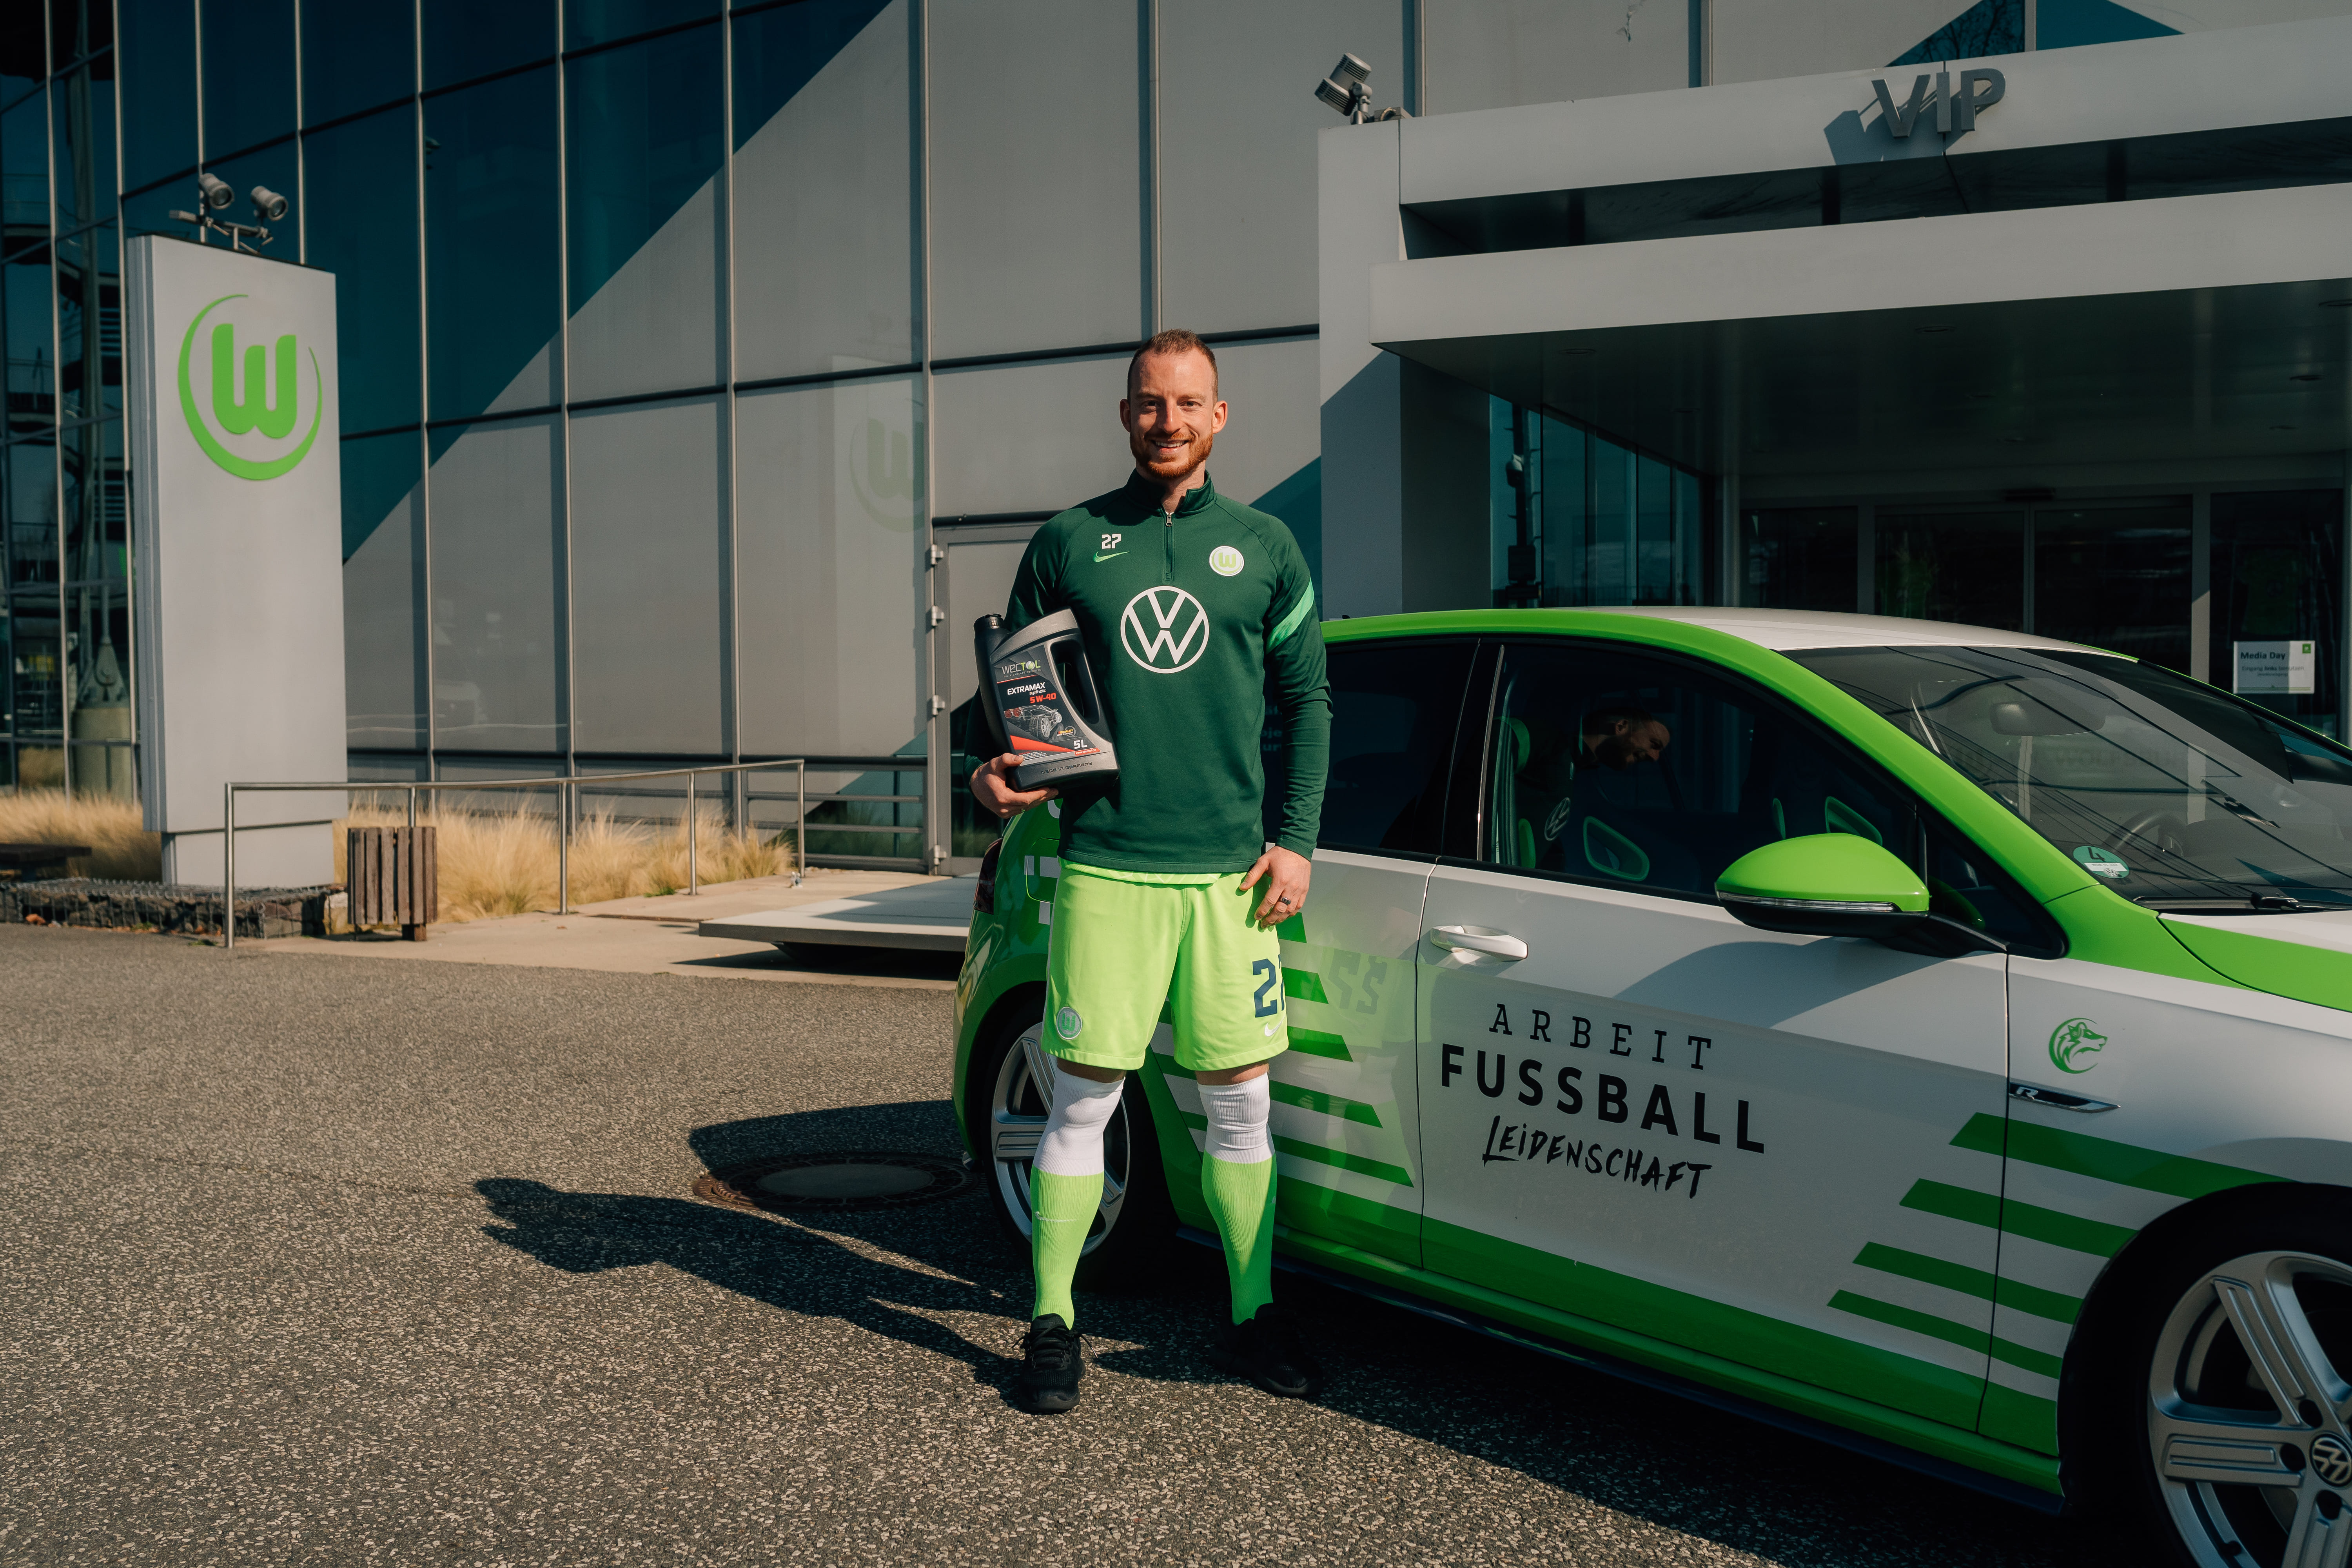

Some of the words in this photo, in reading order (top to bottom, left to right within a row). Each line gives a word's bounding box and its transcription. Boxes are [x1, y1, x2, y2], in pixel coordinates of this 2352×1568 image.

[1871, 68, 2006, 139] VIP
[1101, 534, 1122, 549] 27
[2270, 652, 2286, 661] Day
[1007, 682, 1045, 695] EXTRAMAX
[1030, 693, 1056, 704] 5W-40
[1074, 739, 1088, 749] 5L
[2087, 847, 2106, 862] 4
[1252, 955, 1285, 1018] 2
[1489, 1003, 1712, 1070] ARBEIT
[1441, 1043, 1765, 1154] FUSSBALL
[2016, 1087, 2038, 1100] R
